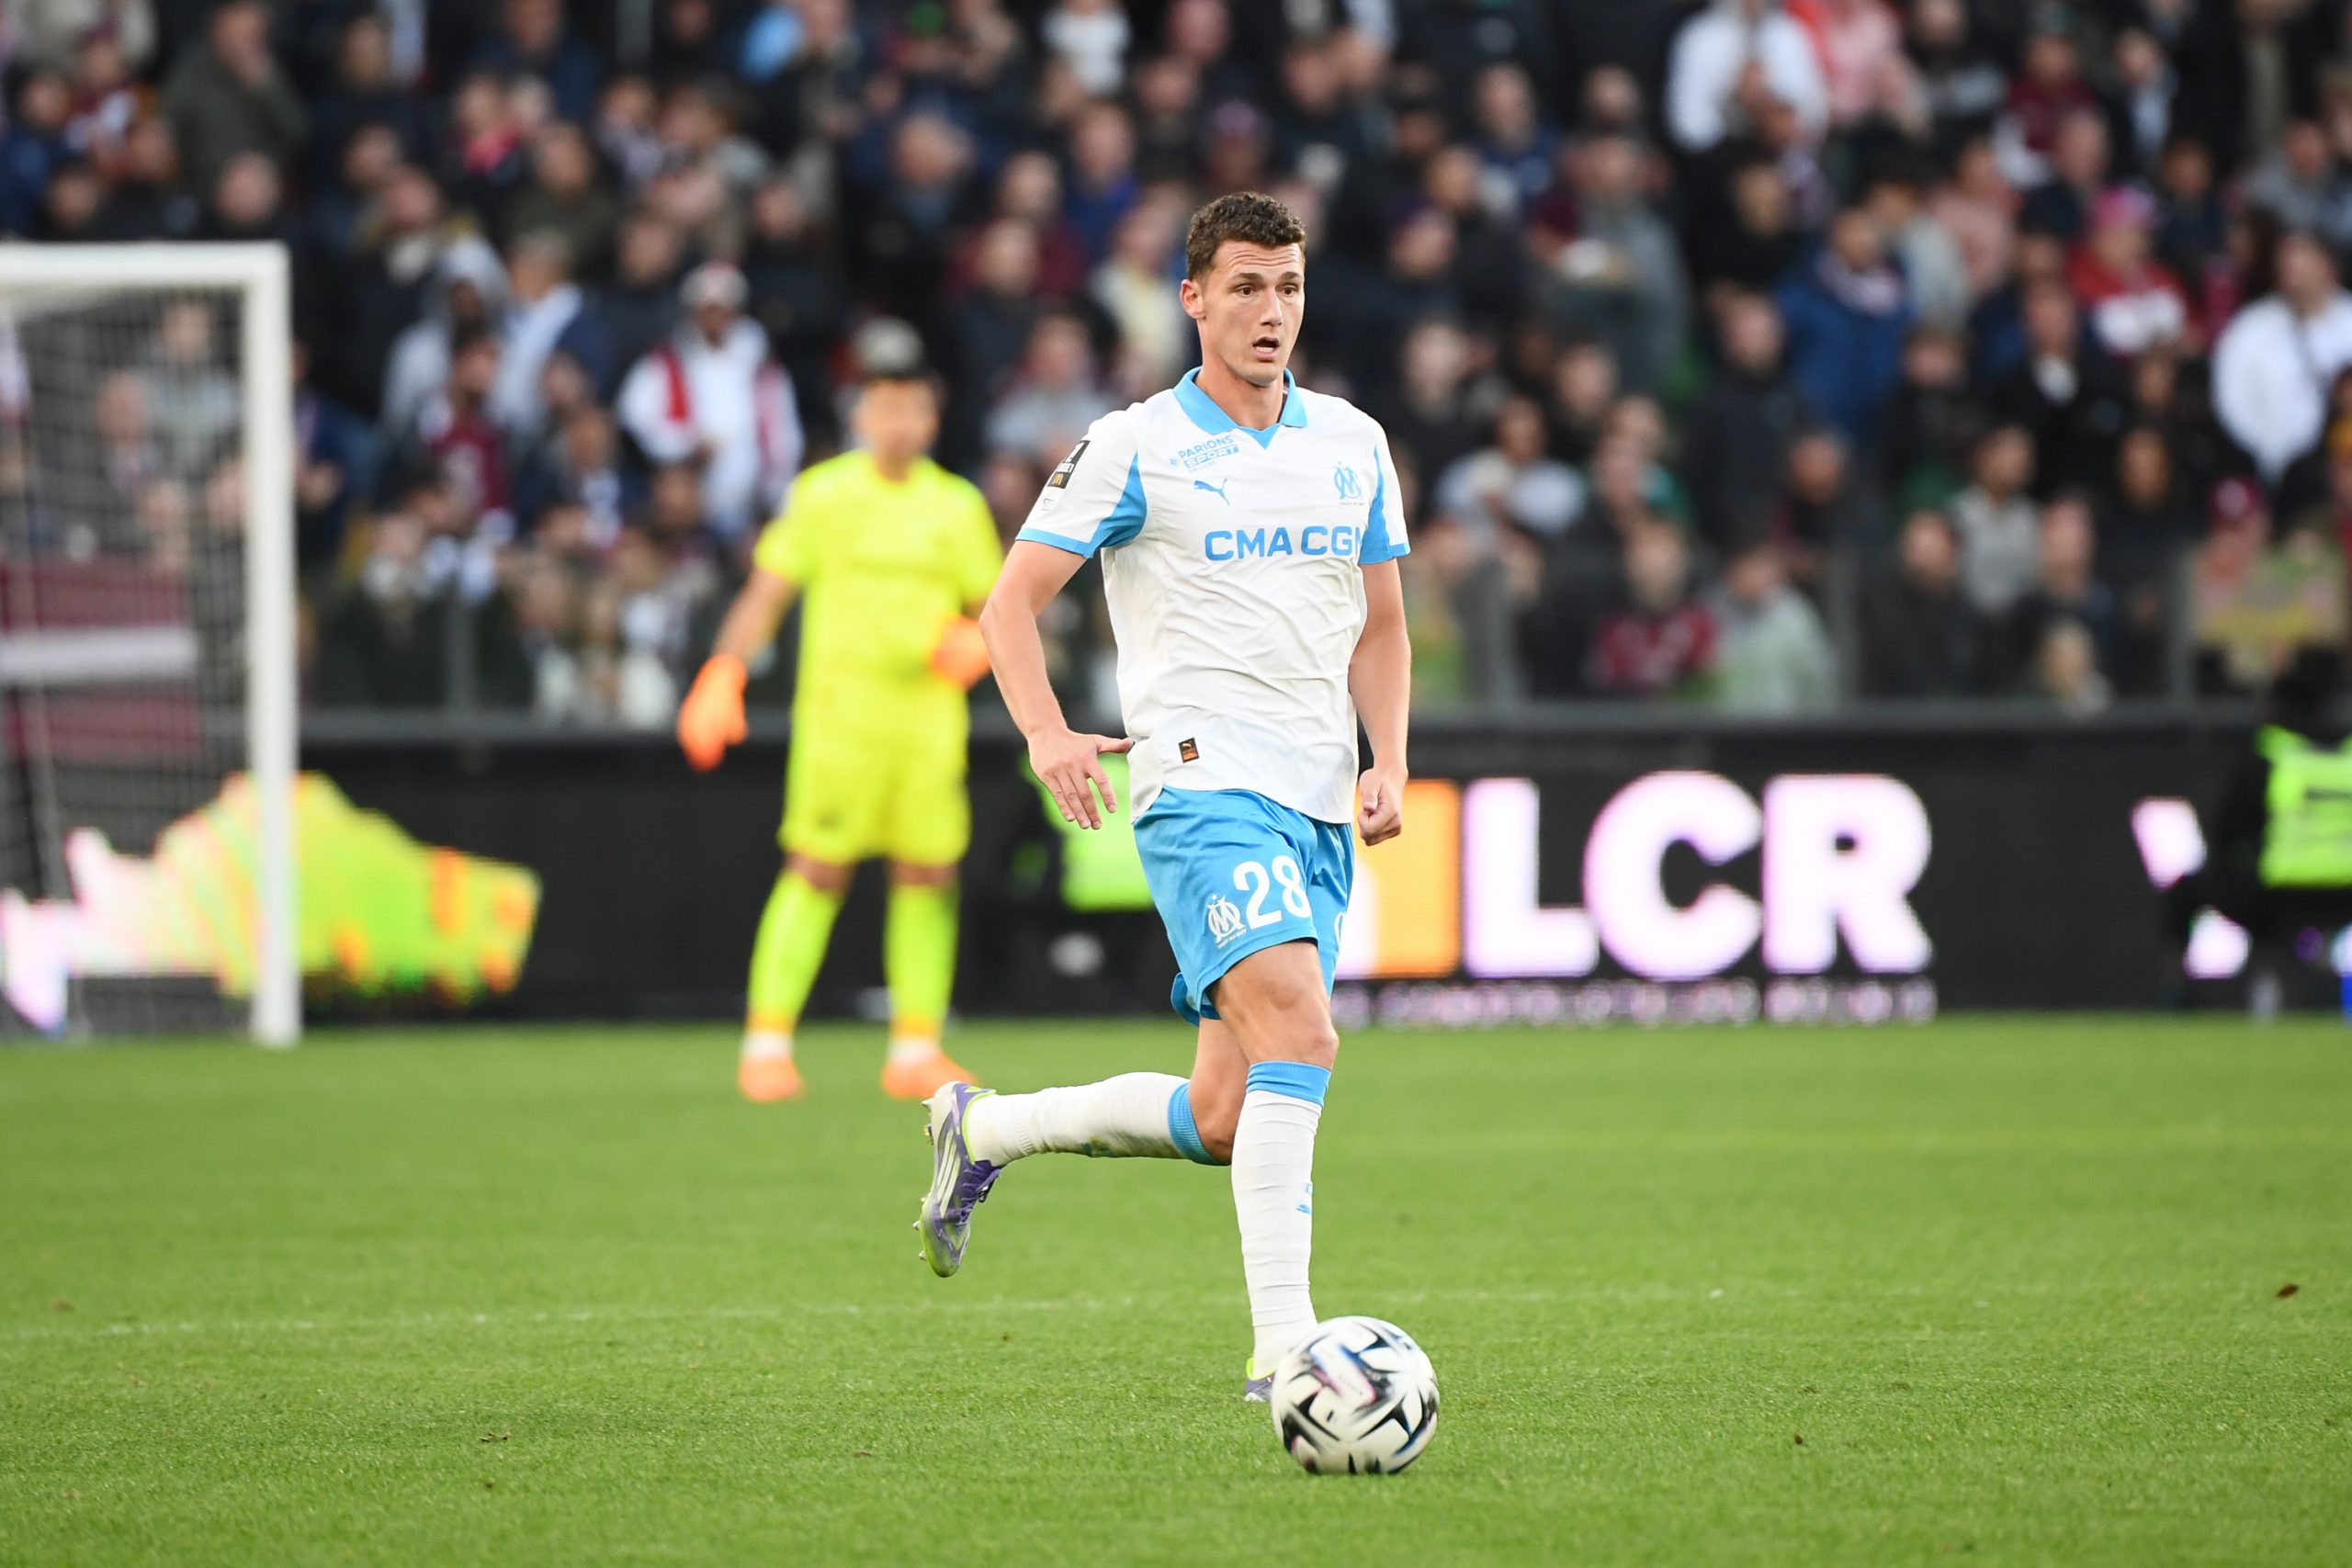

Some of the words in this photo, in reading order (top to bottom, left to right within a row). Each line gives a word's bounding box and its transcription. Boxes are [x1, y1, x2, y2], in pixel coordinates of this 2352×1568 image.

[1178, 435, 1235, 458] PARIONS
[1183, 444, 1240, 468] SPORT
[1204, 526, 1294, 561] CMA
[1462, 769, 1934, 980] LCR
[1233, 855, 1312, 930] 28
